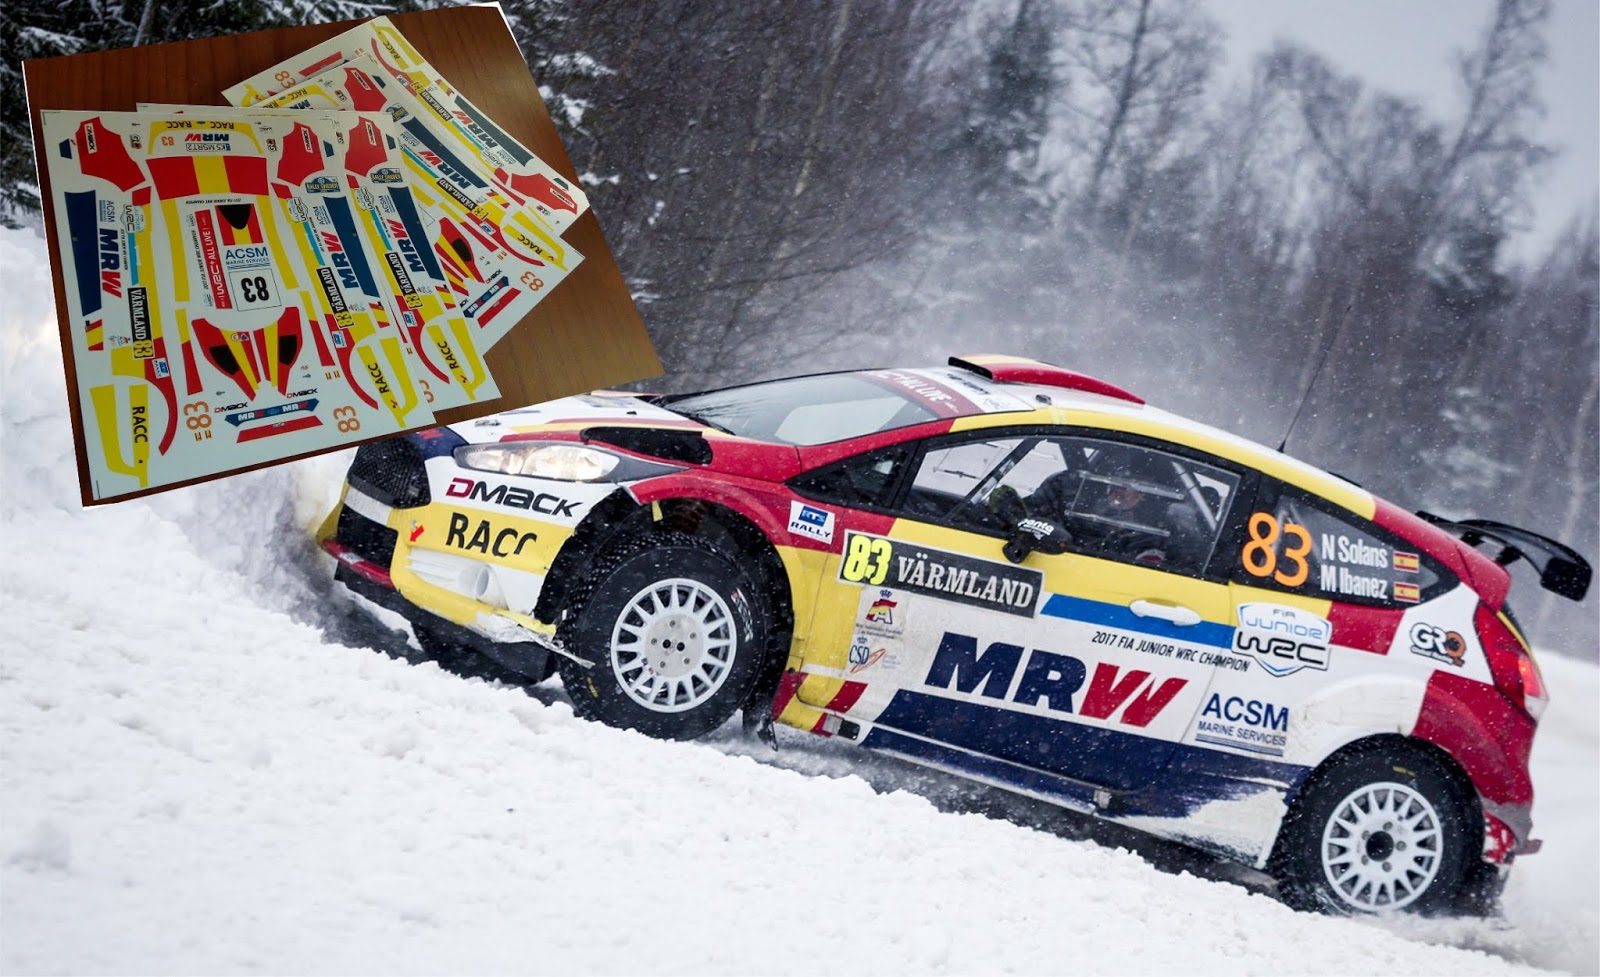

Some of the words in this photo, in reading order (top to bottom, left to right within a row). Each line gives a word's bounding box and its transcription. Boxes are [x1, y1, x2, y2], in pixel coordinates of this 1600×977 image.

[382, 41, 401, 59] RACC
[274, 70, 297, 89] 83
[288, 88, 308, 100] RACC
[167, 120, 192, 128] RACC
[184, 133, 229, 142] MRW
[210, 121, 234, 129] RACC
[451, 110, 498, 148] MRW
[161, 136, 175, 146] 83
[418, 150, 472, 190] MRW
[438, 179, 475, 210] VÄRMLAND
[106, 200, 116, 223] ACSM
[202, 231, 214, 246] LIVE
[386, 218, 426, 273] MRW
[517, 234, 543, 255] RACC
[99, 228, 122, 298] MRW
[208, 246, 216, 260] ALL
[225, 246, 269, 260] ACSM
[320, 230, 360, 289] MRW
[388, 253, 415, 294] VÄRMLAND
[520, 270, 544, 292] 83
[240, 276, 270, 303] 83
[320, 268, 345, 312] VÄRMLAND
[130, 289, 147, 341] VÄRMLAND
[132, 338, 154, 359] 83
[437, 340, 460, 369] RACC
[367, 363, 390, 394] RACC
[282, 401, 309, 412] MRW
[287, 388, 318, 399] DMACK
[183, 401, 212, 430] 83
[214, 402, 248, 413] DMACK
[237, 410, 265, 421] MRW
[333, 406, 360, 433] 83
[132, 405, 148, 443] RACC
[446, 477, 583, 517] DMACK
[791, 522, 831, 538] RALLY
[1241, 512, 1313, 587] 83
[1321, 533, 1337, 561] N
[1338, 535, 1388, 568] Solans
[843, 535, 893, 586] 83
[898, 552, 1034, 608] VÄRMLAND
[1320, 564, 1337, 593] M
[1338, 567, 1388, 600] Ibanez
[1273, 608, 1296, 618] FIA
[1246, 619, 1323, 640] JUNIOR
[849, 645, 870, 665] CSD
[1091, 631, 1116, 646] 2017
[1117, 636, 1135, 650] FIA
[1135, 640, 1173, 657] JUNIOR
[1173, 647, 1199, 663] WRC
[1199, 652, 1251, 672] CHAMPION
[1236, 631, 1327, 666] WRC
[924, 631, 1189, 728] MRW
[1201, 693, 1289, 732] ACSM
[1198, 721, 1235, 736] MARINE
[1236, 728, 1287, 746] SERVICES
